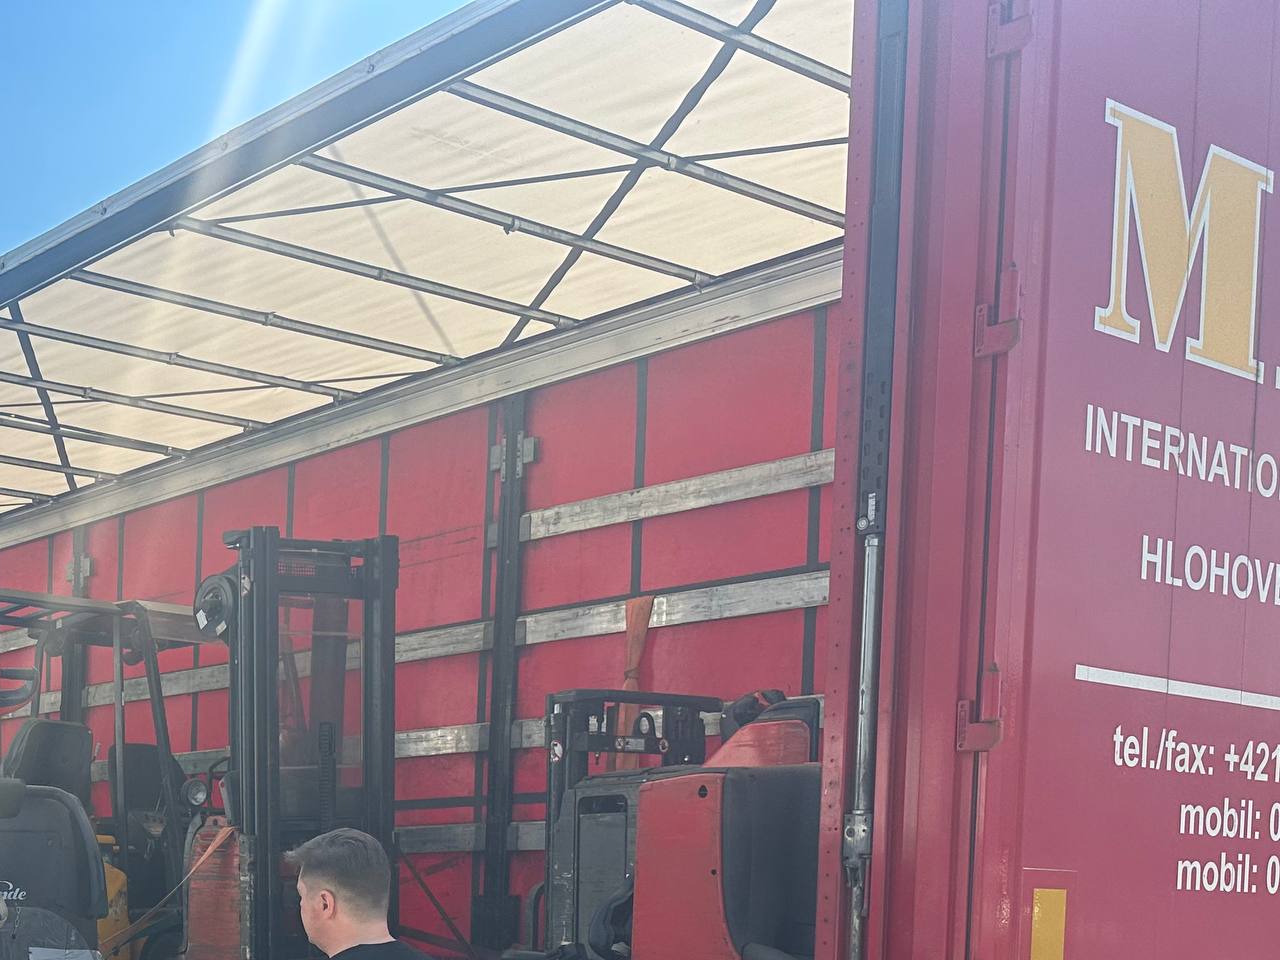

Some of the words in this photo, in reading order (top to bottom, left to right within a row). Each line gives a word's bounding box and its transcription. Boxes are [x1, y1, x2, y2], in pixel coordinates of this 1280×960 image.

[1085, 404, 1280, 501] INTERNATIO
[1113, 724, 1215, 776] tel./fax:
[1179, 797, 1261, 840] mobil:
[1176, 852, 1258, 893] mobil:
